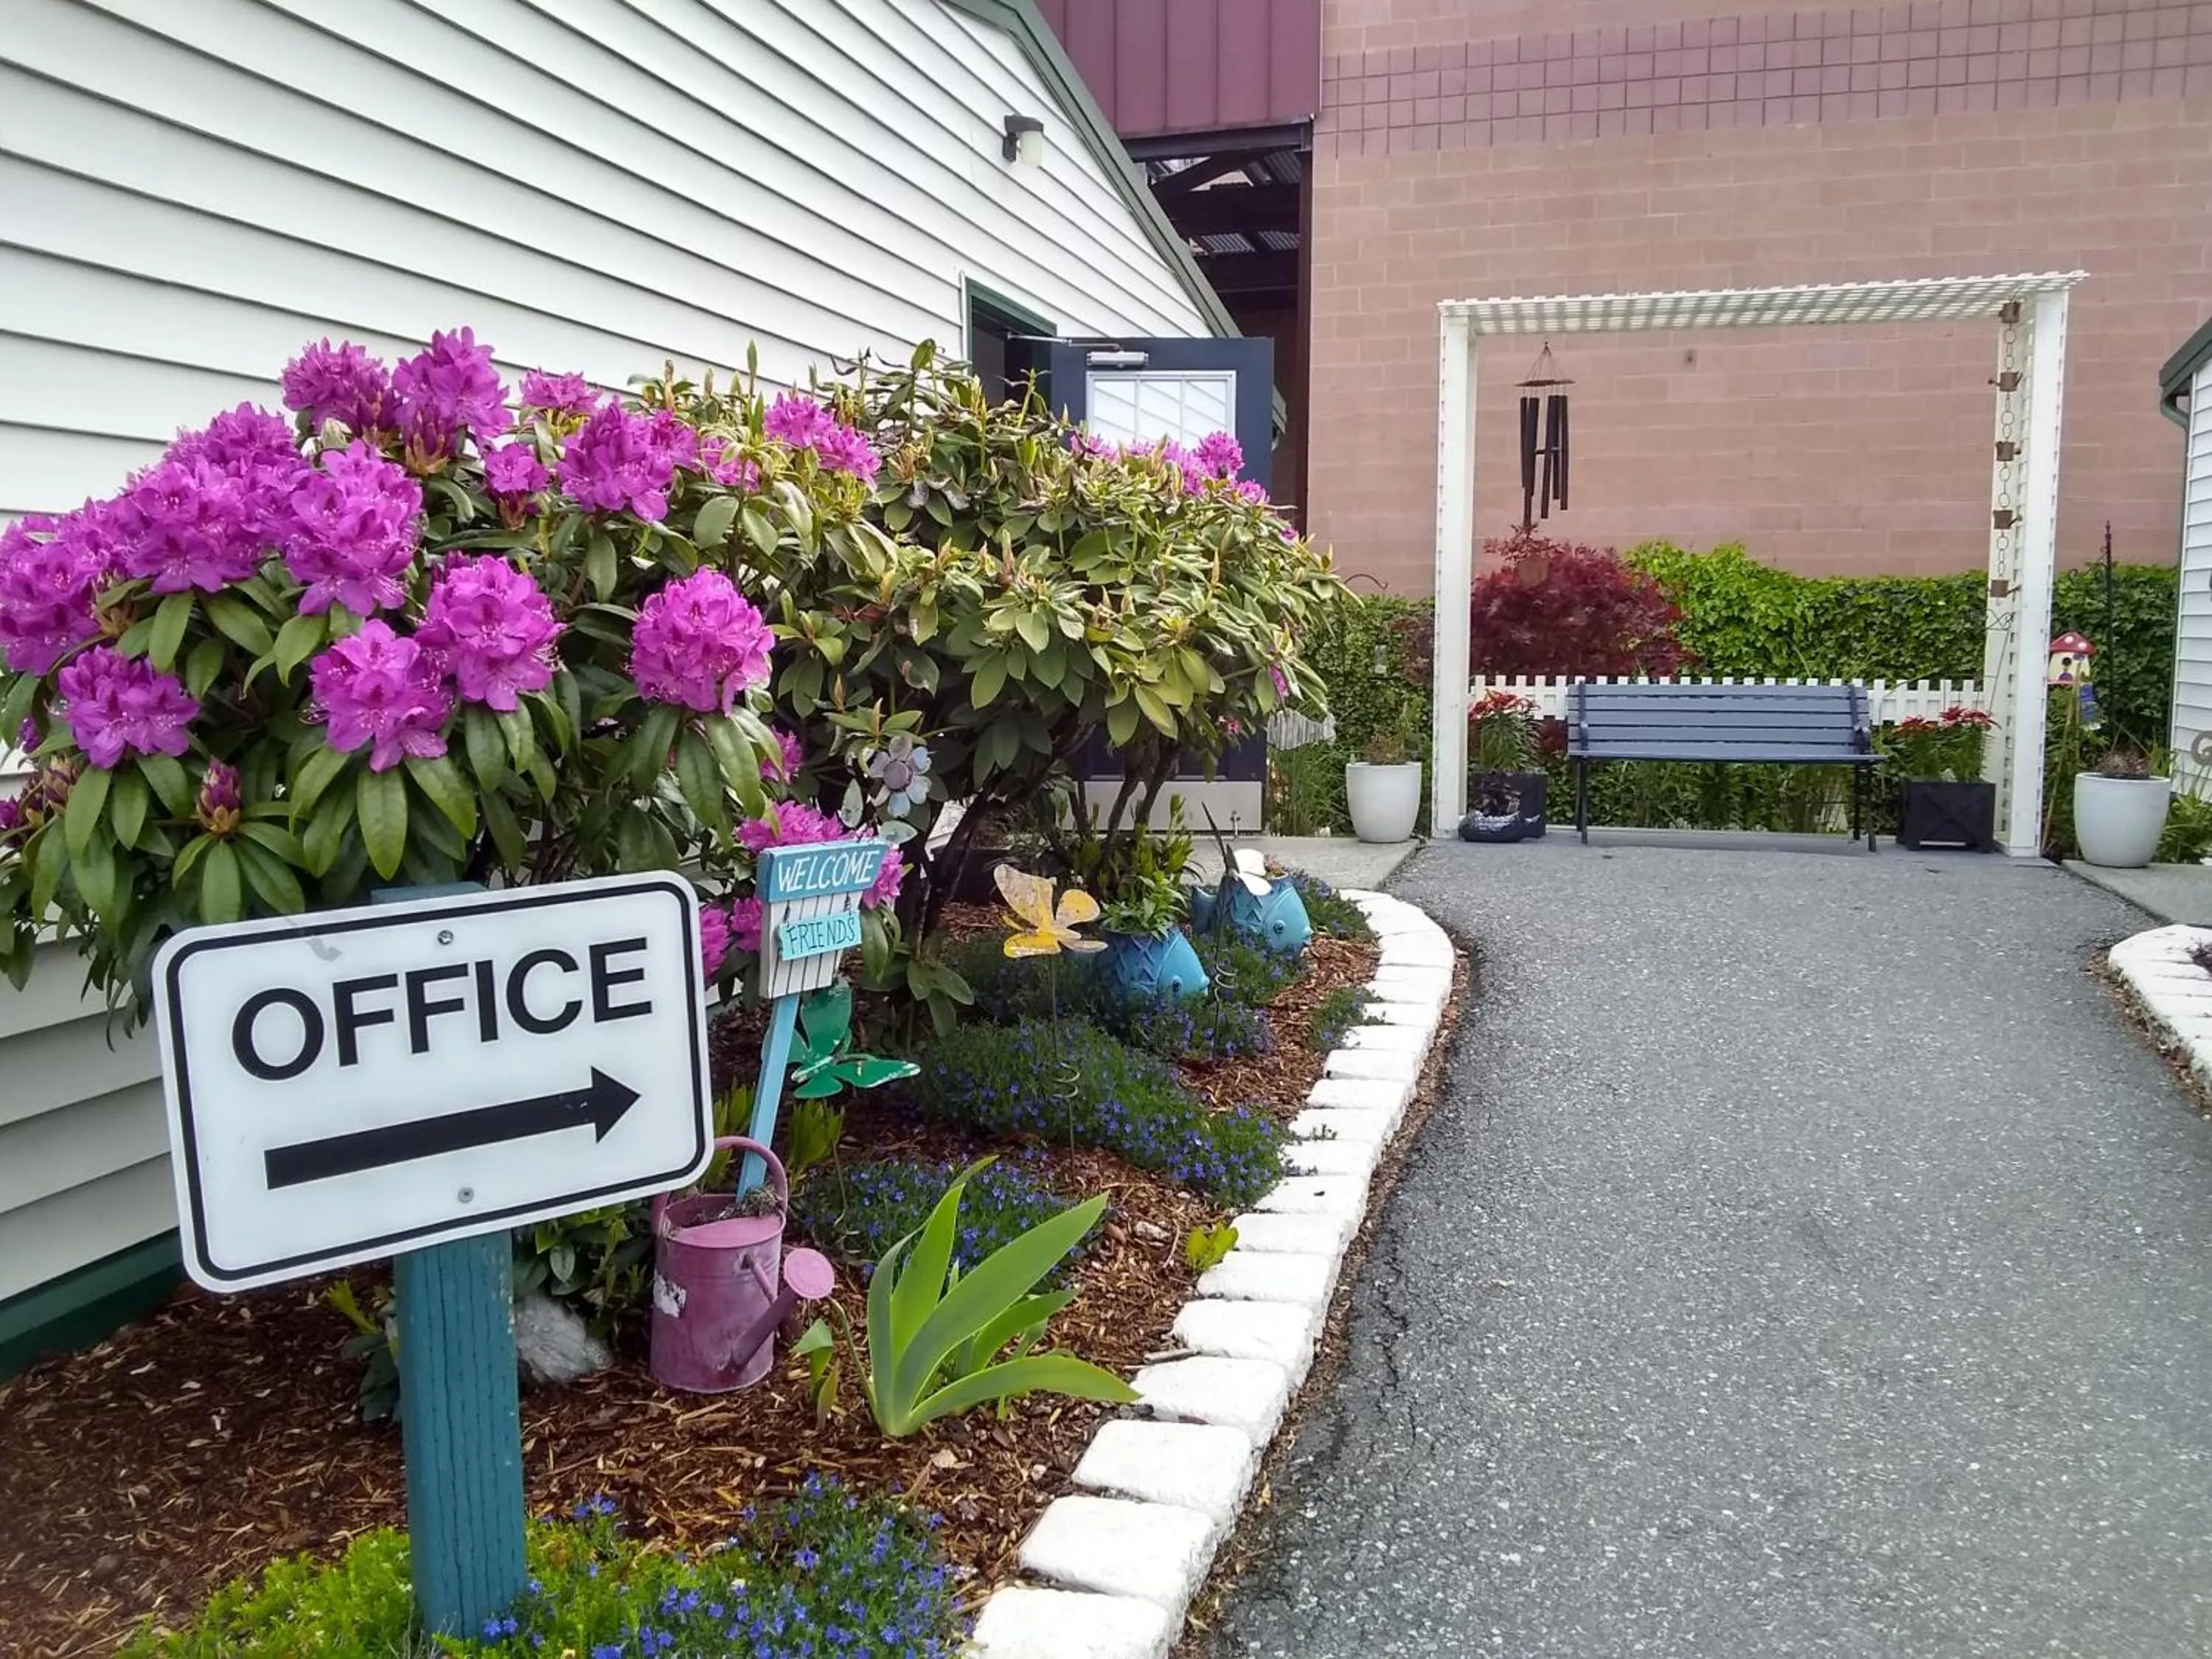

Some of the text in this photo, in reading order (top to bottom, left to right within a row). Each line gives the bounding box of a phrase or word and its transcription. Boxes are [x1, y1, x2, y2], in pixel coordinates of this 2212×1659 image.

[778, 850, 880, 892] WELCOME
[786, 917, 855, 955] FRIENDS
[232, 937, 653, 1081] OFFICE
